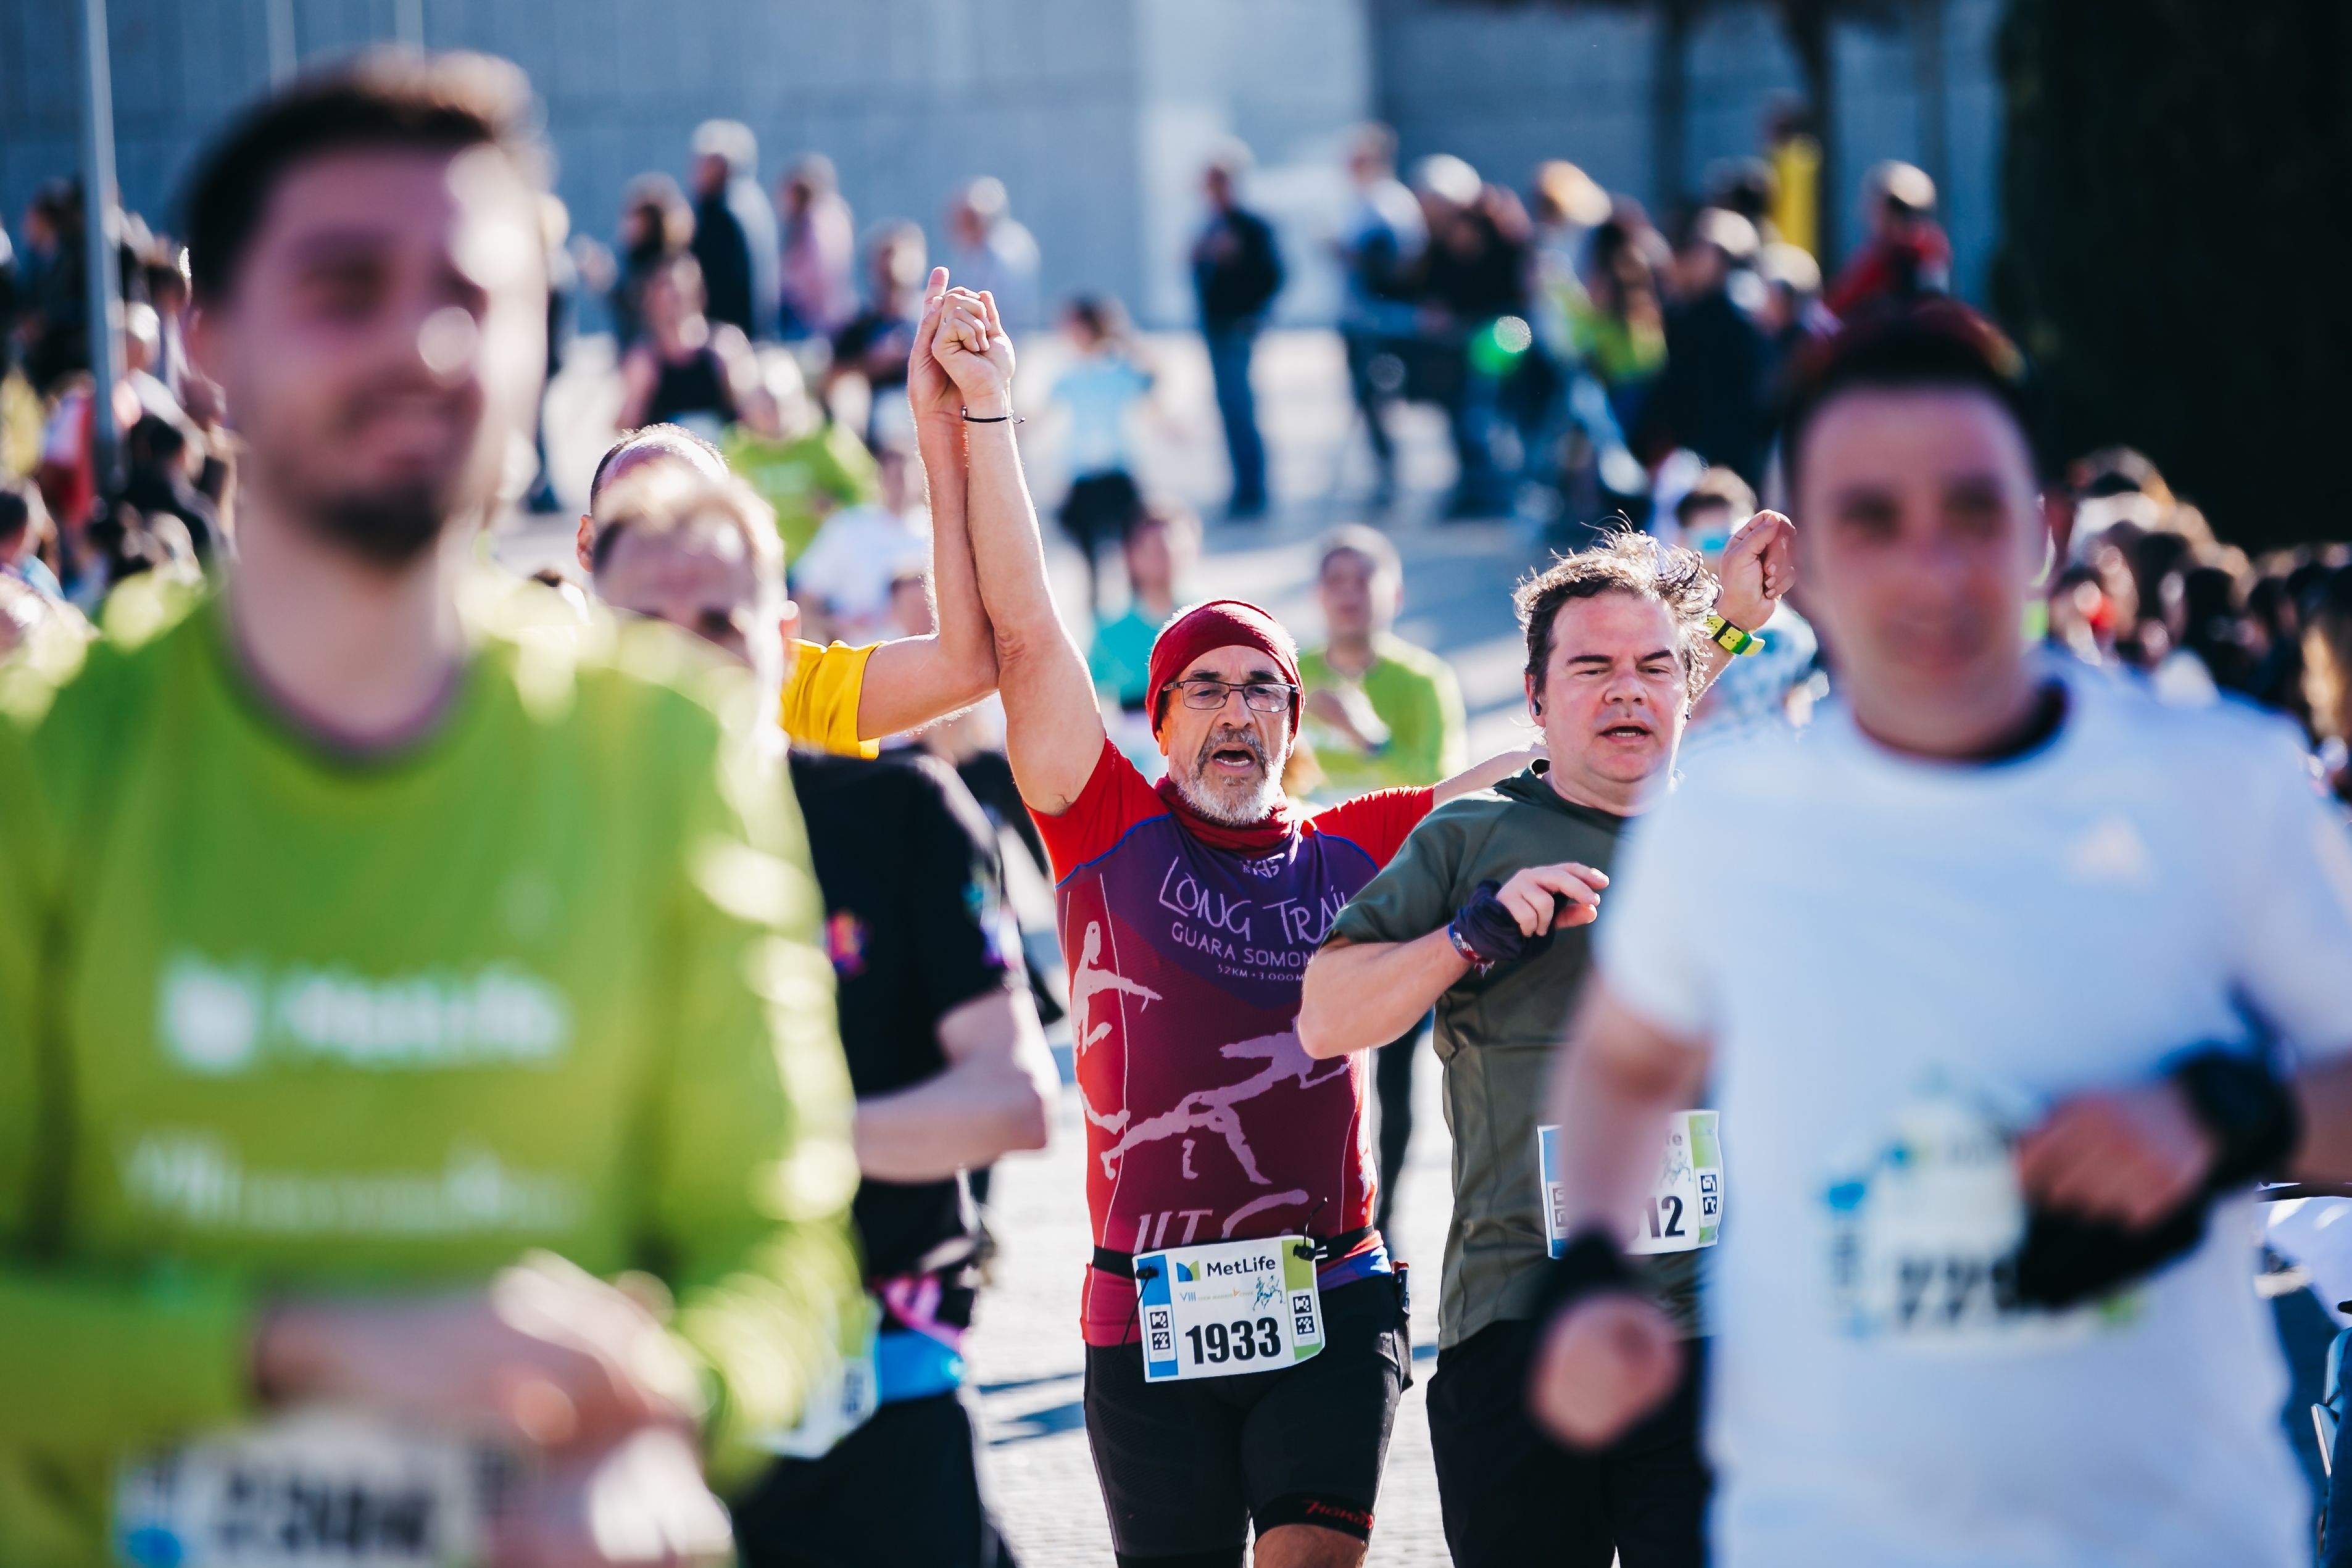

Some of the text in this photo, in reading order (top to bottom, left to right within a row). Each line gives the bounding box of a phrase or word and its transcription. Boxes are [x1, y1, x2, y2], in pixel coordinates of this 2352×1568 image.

[1160, 856, 1252, 942] LONG
[1171, 921, 1313, 968] GUARA SOMON
[1207, 1255, 1276, 1278] MetLife
[1179, 1291, 1196, 1302] VIII
[1185, 1317, 1282, 1365] 1933
